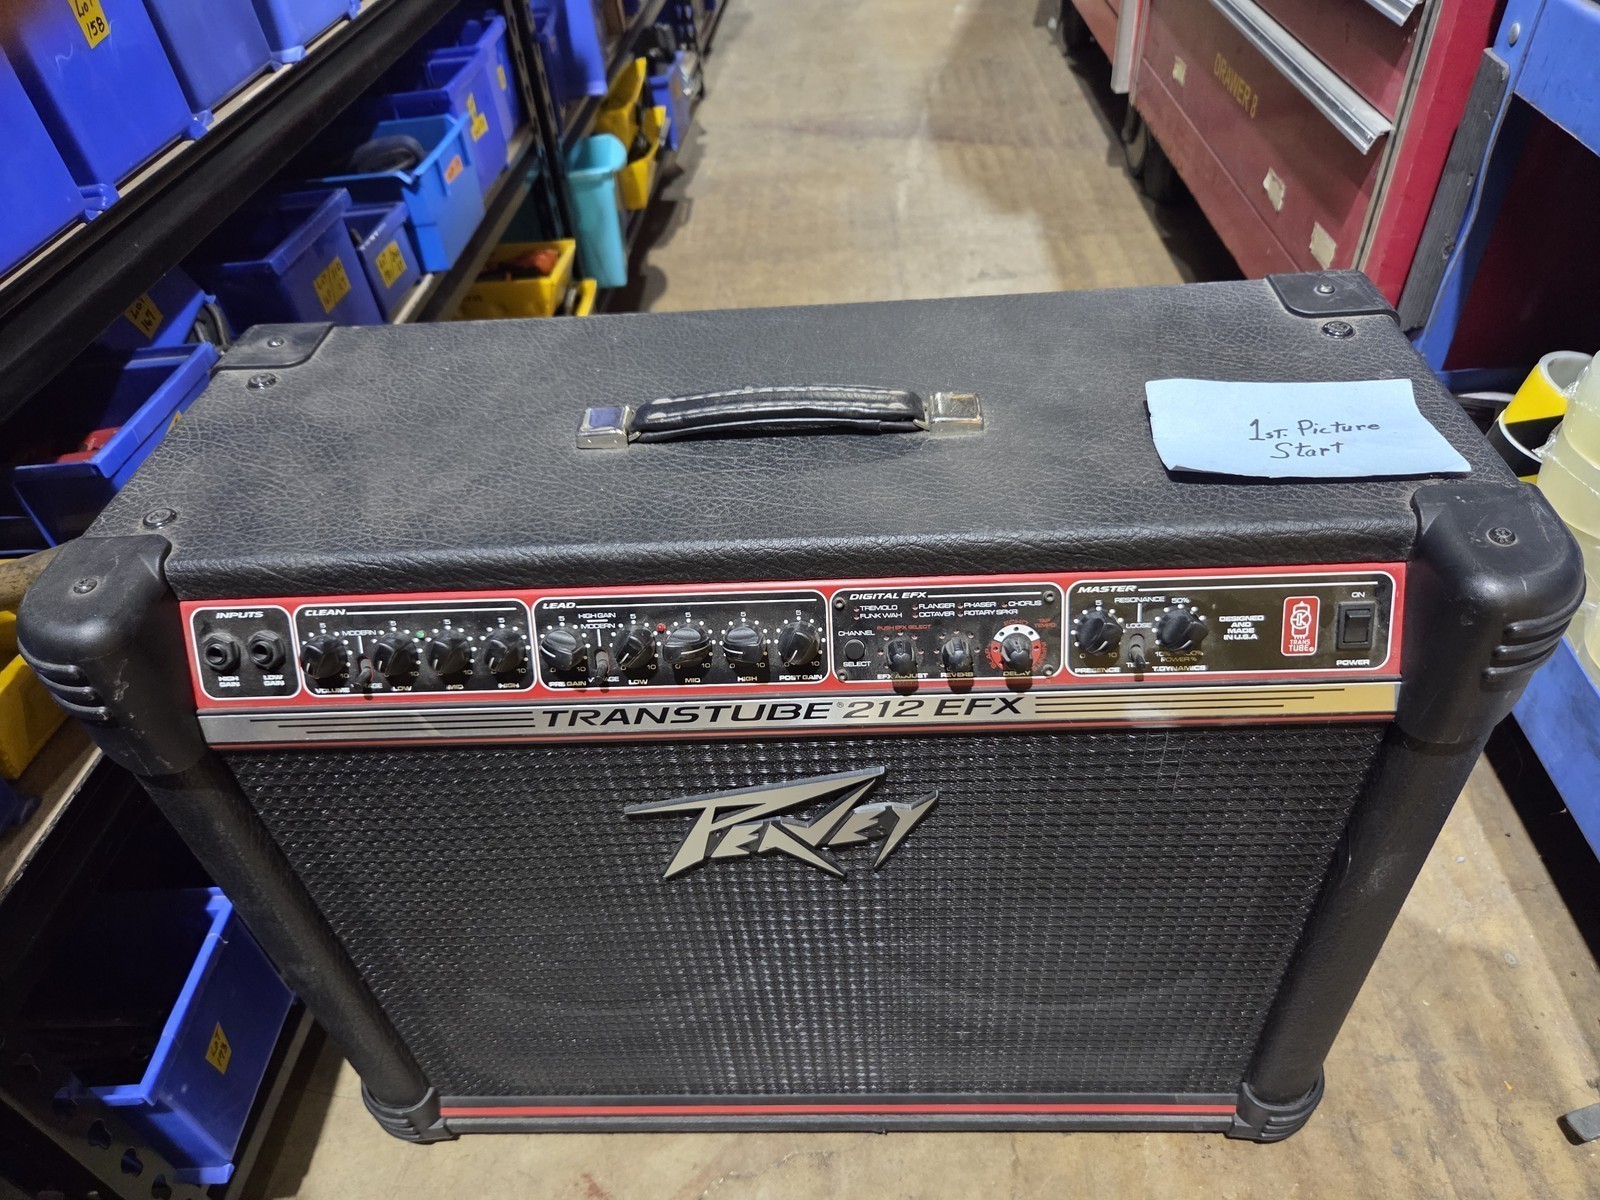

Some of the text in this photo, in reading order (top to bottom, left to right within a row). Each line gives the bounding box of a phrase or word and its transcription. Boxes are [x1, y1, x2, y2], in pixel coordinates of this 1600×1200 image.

[86, 16, 105, 40] 158
[1214, 52, 1258, 118] DRAWER 8
[140, 308, 156, 332] 167
[1297, 419, 1380, 436] Picture
[1270, 441, 1344, 459] Start
[1077, 585, 1138, 594] MASTER
[849, 592, 900, 600] DIGITAL
[1114, 596, 1166, 604] RESONANCE
[542, 602, 576, 610] LEAD
[215, 611, 264, 619] INPUTS
[304, 609, 346, 617] CLEAN
[996, 608, 1019, 616] SPKR
[1218, 614, 1265, 622] DESIGNED
[1074, 666, 1121, 674] PRESENCE
[842, 700, 925, 718] 212
[934, 697, 1025, 716] EFX
[624, 766, 938, 880] PEAVEY
